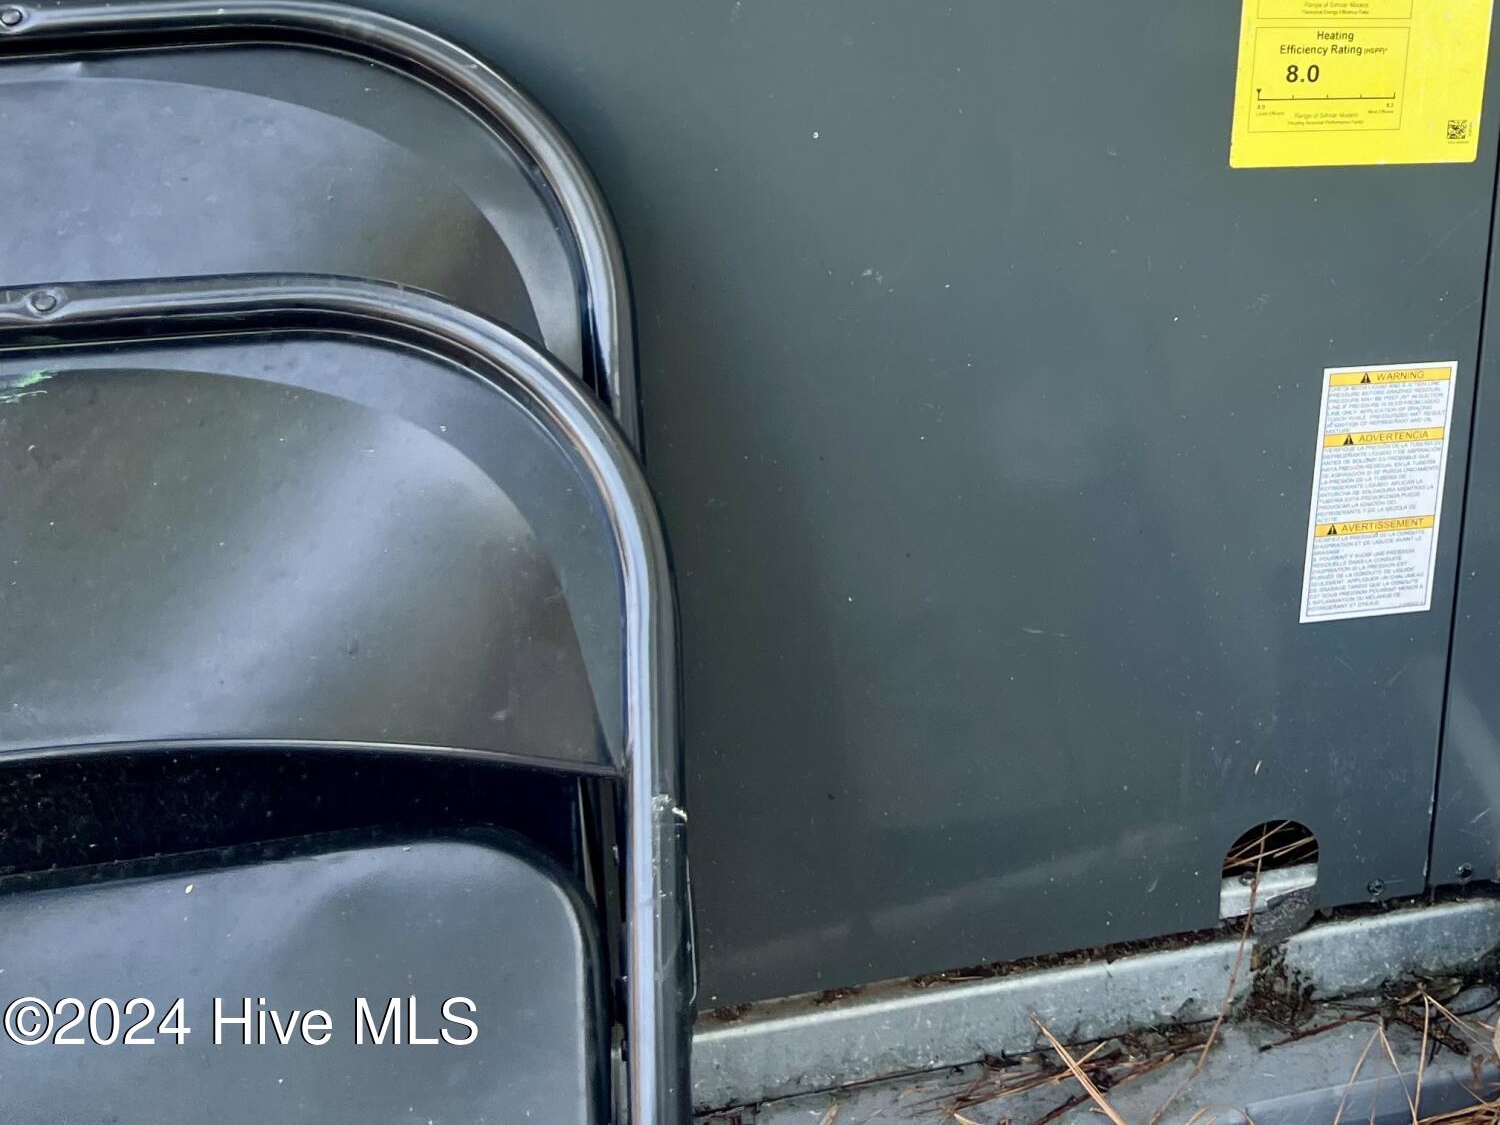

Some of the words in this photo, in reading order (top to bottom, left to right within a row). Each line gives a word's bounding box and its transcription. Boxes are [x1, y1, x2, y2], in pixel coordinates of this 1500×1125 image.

[1317, 31, 1354, 42] Heating
[1280, 45, 1327, 56] Efficiency
[1331, 45, 1362, 56] Rating
[1286, 64, 1320, 83] 8.0
[1376, 370, 1425, 381] WARNING
[1358, 431, 1429, 442] ADVERTENCIA
[1341, 518, 1424, 532] AVERTISSEMENT
